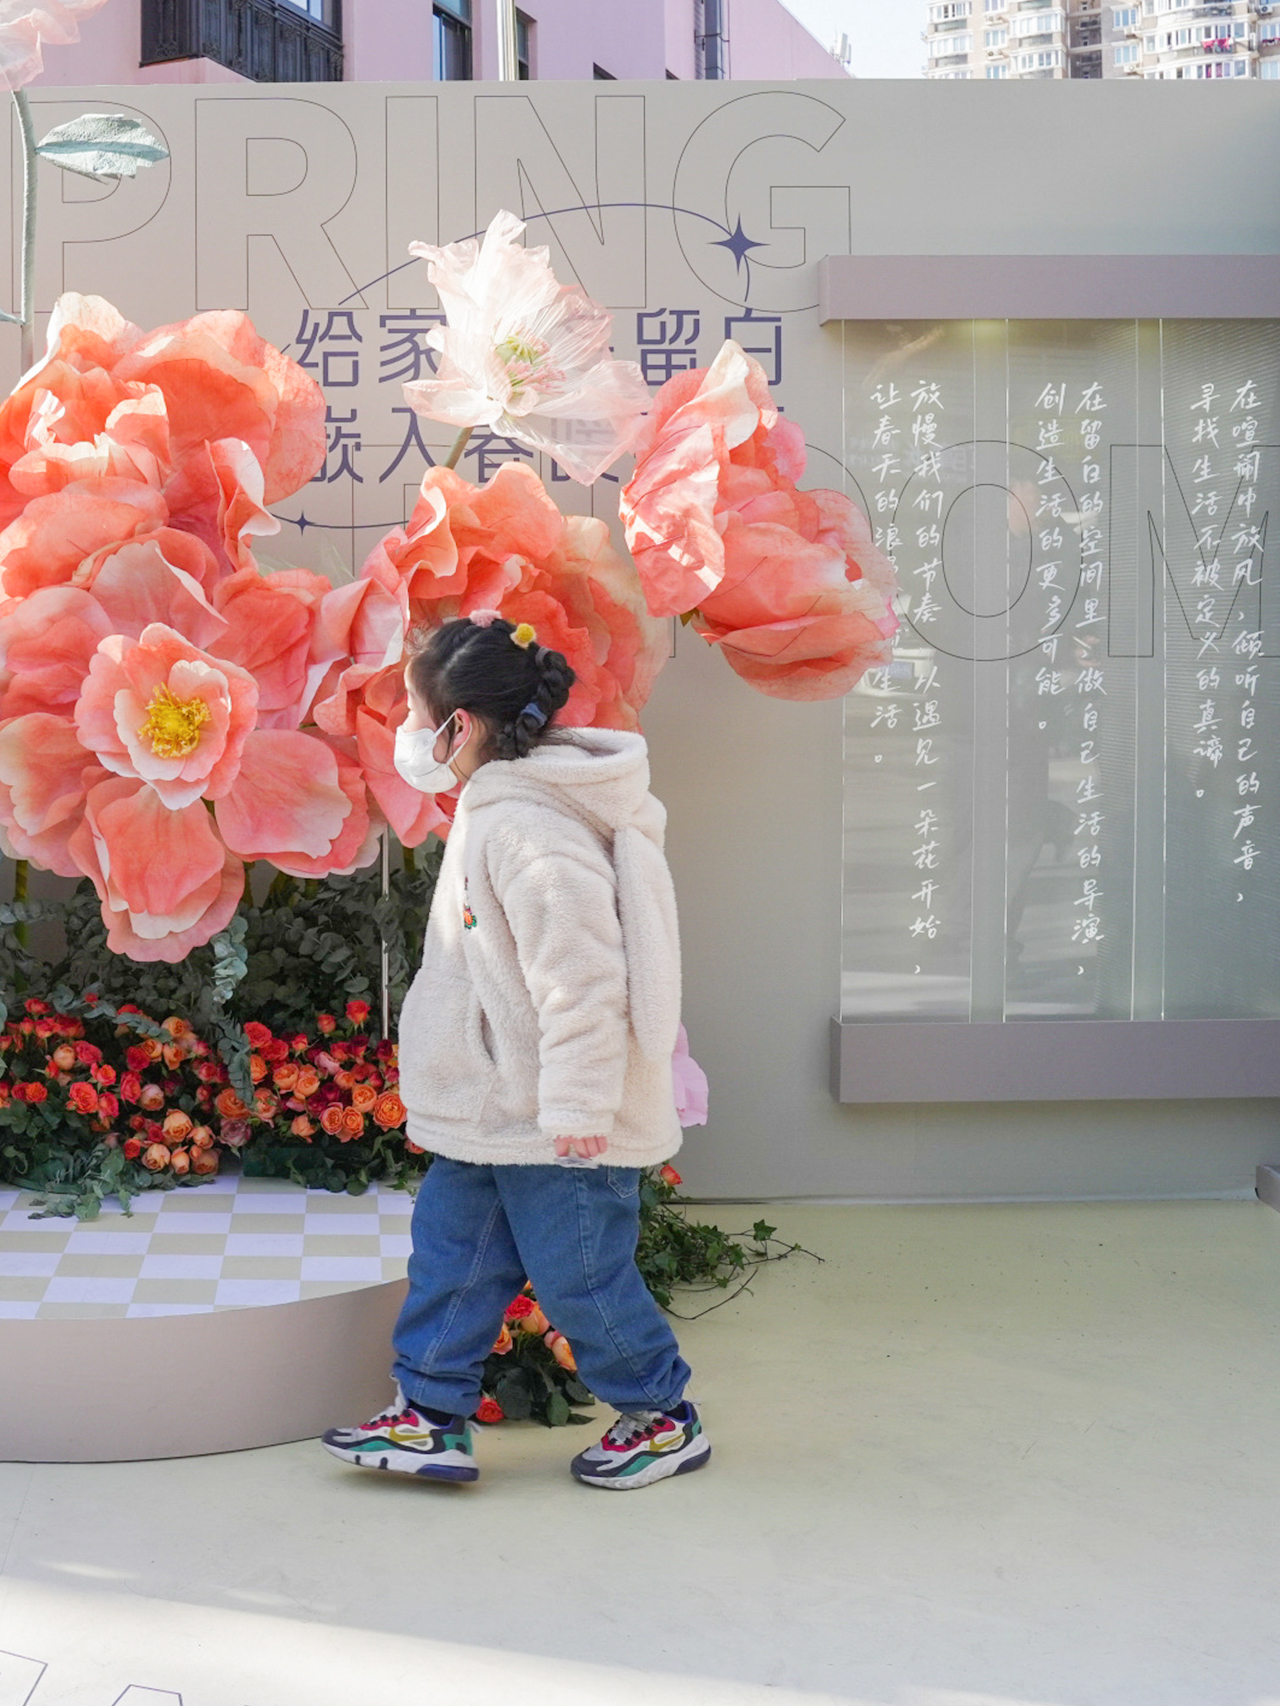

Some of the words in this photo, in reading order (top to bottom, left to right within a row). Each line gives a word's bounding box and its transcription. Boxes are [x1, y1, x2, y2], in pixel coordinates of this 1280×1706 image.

[295, 308, 782, 388] 给家留白
[869, 382, 904, 764] 让春天的浪生活。
[1034, 382, 1066, 731] 创造生活的更多可能。
